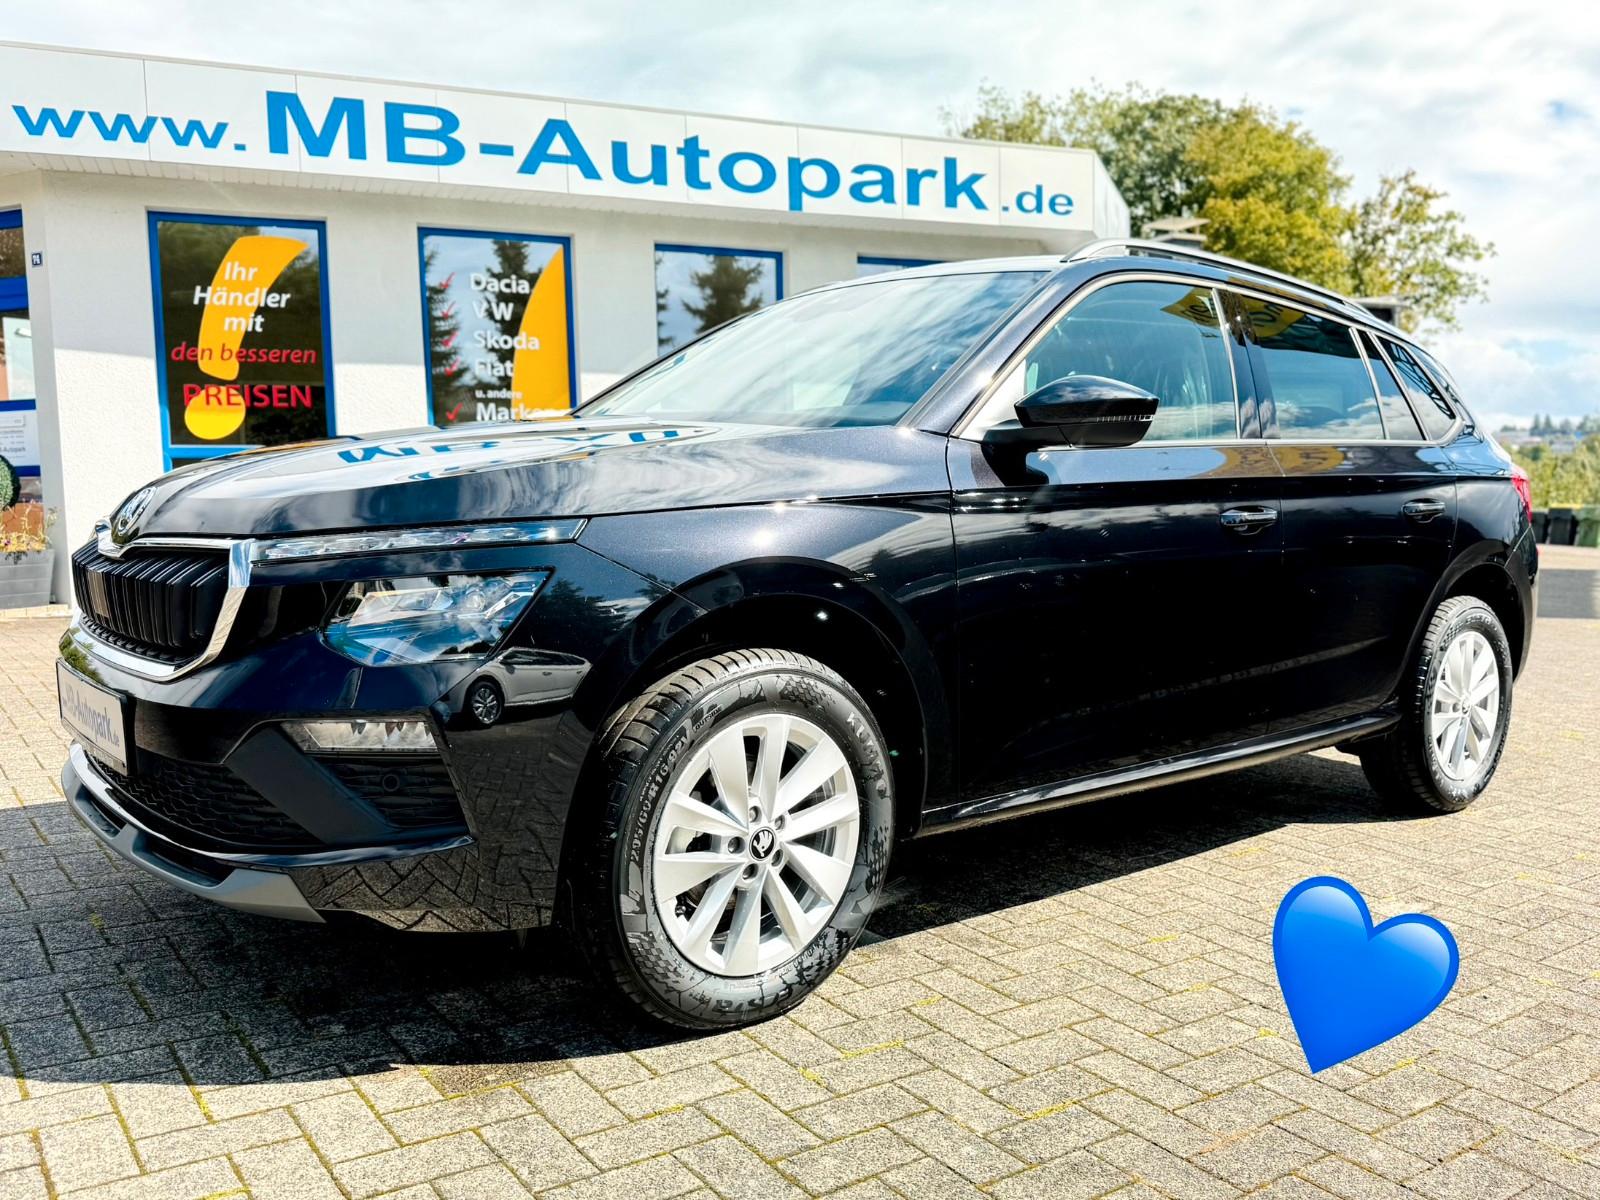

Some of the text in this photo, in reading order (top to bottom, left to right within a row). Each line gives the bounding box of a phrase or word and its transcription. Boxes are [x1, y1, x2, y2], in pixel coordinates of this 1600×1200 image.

[224, 261, 258, 281] Ihr
[469, 272, 531, 294] Dacia
[193, 285, 292, 308] Händler
[223, 313, 265, 332] mit
[473, 330, 540, 350] Skoda
[171, 341, 317, 364] den besseren
[474, 359, 514, 377] Fiat
[183, 383, 312, 408] PREISEN
[486, 388, 523, 399] andere
